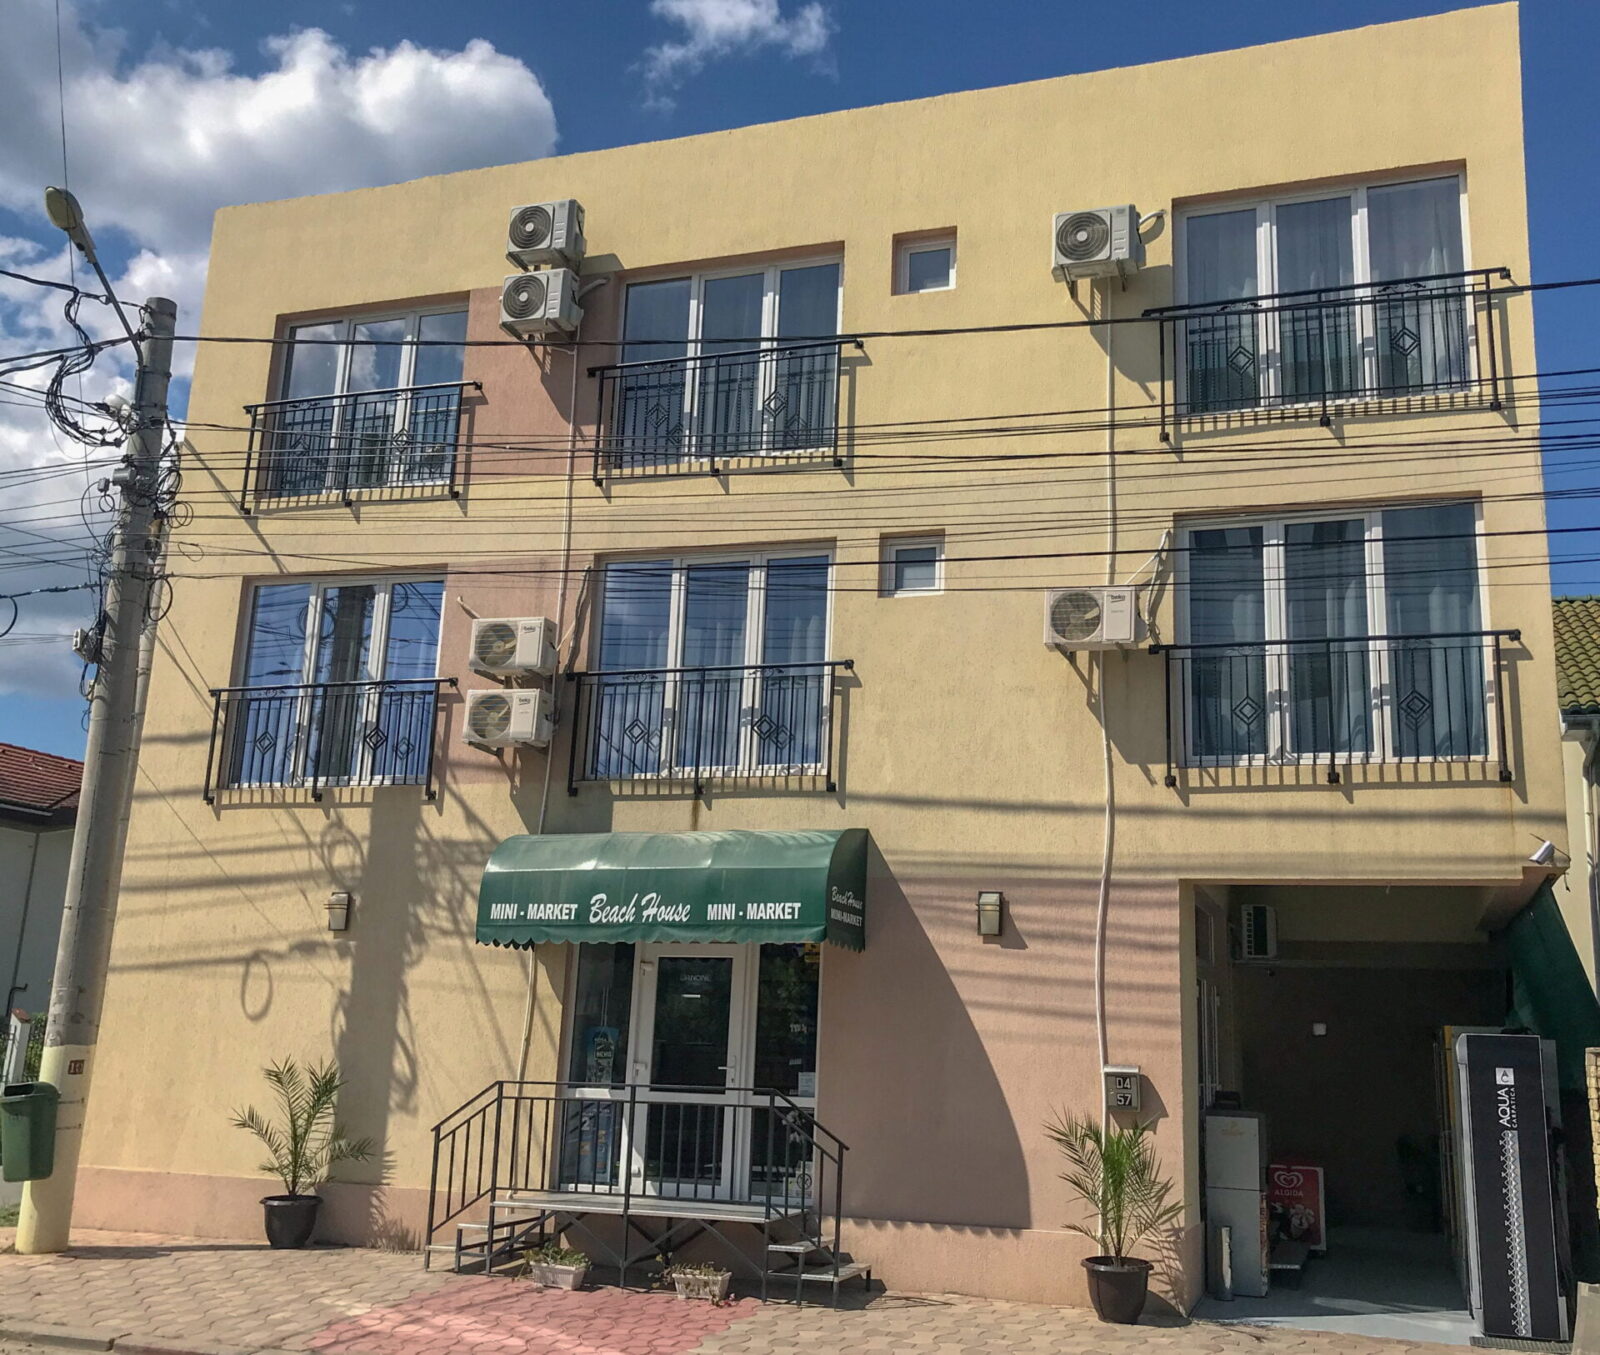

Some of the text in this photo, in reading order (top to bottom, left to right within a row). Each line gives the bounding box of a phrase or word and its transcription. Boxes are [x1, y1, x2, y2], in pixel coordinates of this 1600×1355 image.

[490, 903, 518, 920] MINI
[526, 903, 578, 920] MARKET
[589, 892, 638, 924] Beach
[640, 892, 691, 923] House
[706, 903, 736, 921] MINI
[746, 902, 801, 920] MARKET
[1117, 1093, 1132, 1105] 57
[1497, 1087, 1511, 1128] AQUA
[1510, 1087, 1518, 1129] CARPATICA
[1274, 1189, 1304, 1197] ALGIDA
